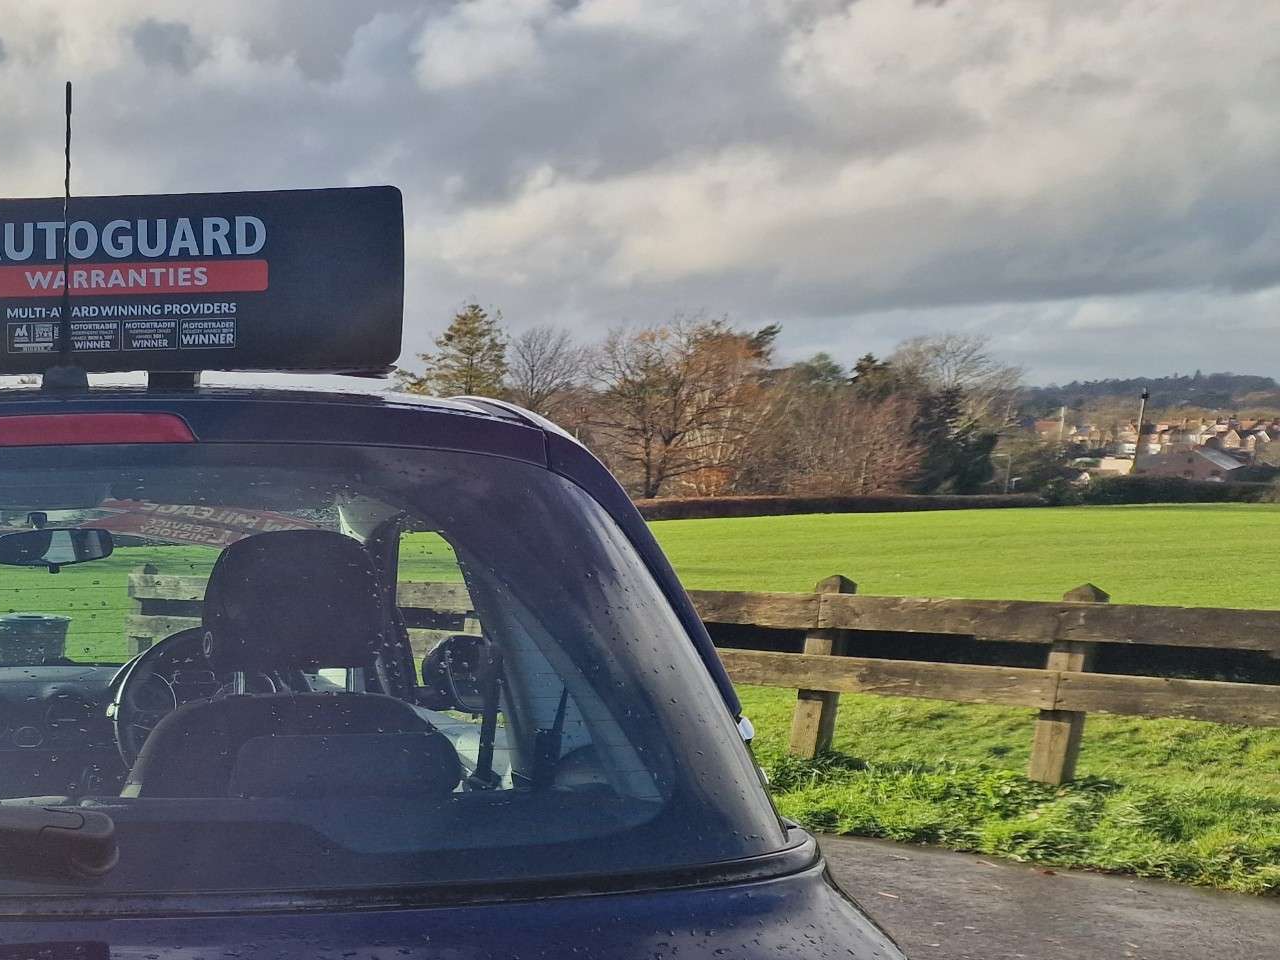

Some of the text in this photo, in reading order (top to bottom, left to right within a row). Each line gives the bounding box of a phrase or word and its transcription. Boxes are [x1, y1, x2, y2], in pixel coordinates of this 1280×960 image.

[25, 267, 209, 290] WARRANTIES
[6, 302, 237, 319] MULTI-AARD WINNING PROVIDERS
[70, 322, 118, 331] OTORTRADER
[131, 339, 169, 348] WINNER
[181, 333, 234, 345] WINNER
[73, 340, 111, 349] WINNER
